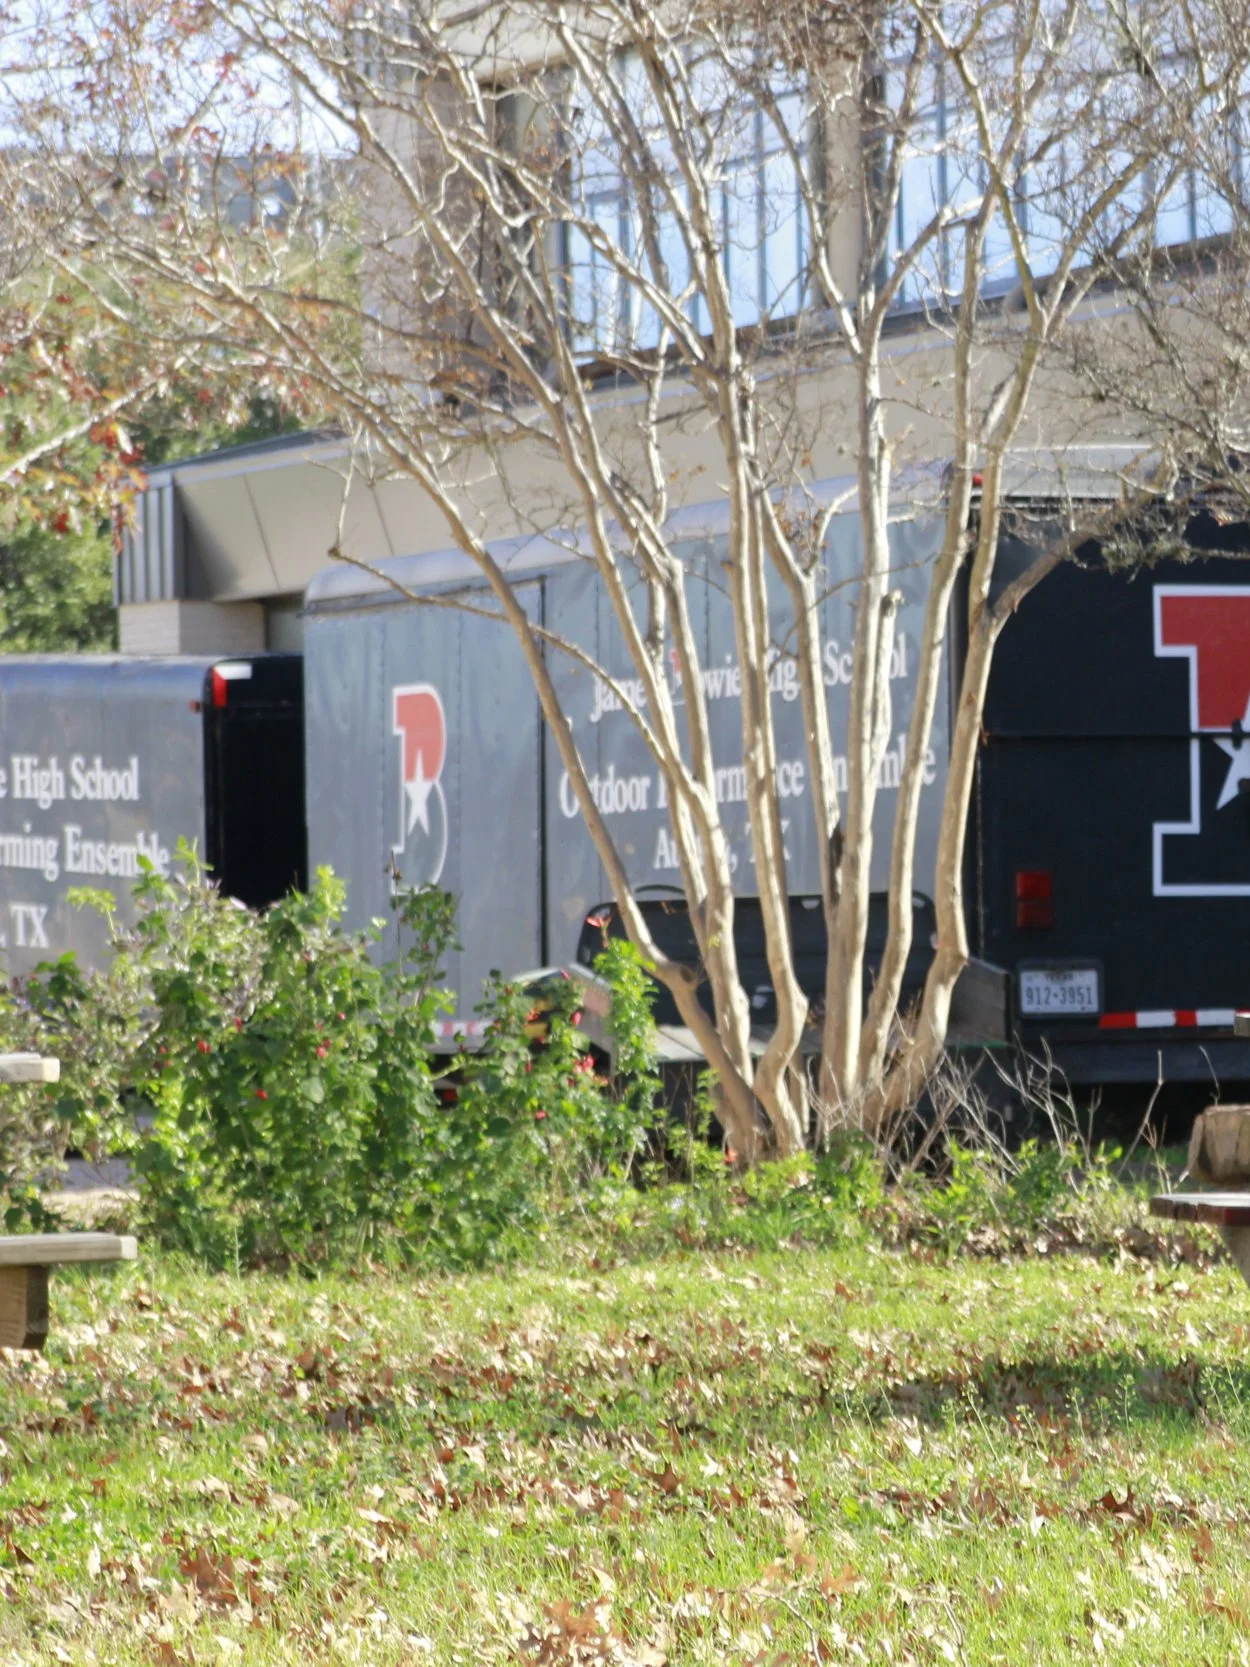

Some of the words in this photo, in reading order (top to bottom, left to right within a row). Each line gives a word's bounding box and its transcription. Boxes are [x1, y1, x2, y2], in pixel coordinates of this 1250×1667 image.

[11, 756, 65, 809] High
[70, 756, 139, 801] School
[559, 764, 650, 818] Otdoor
[10, 902, 50, 949] TX
